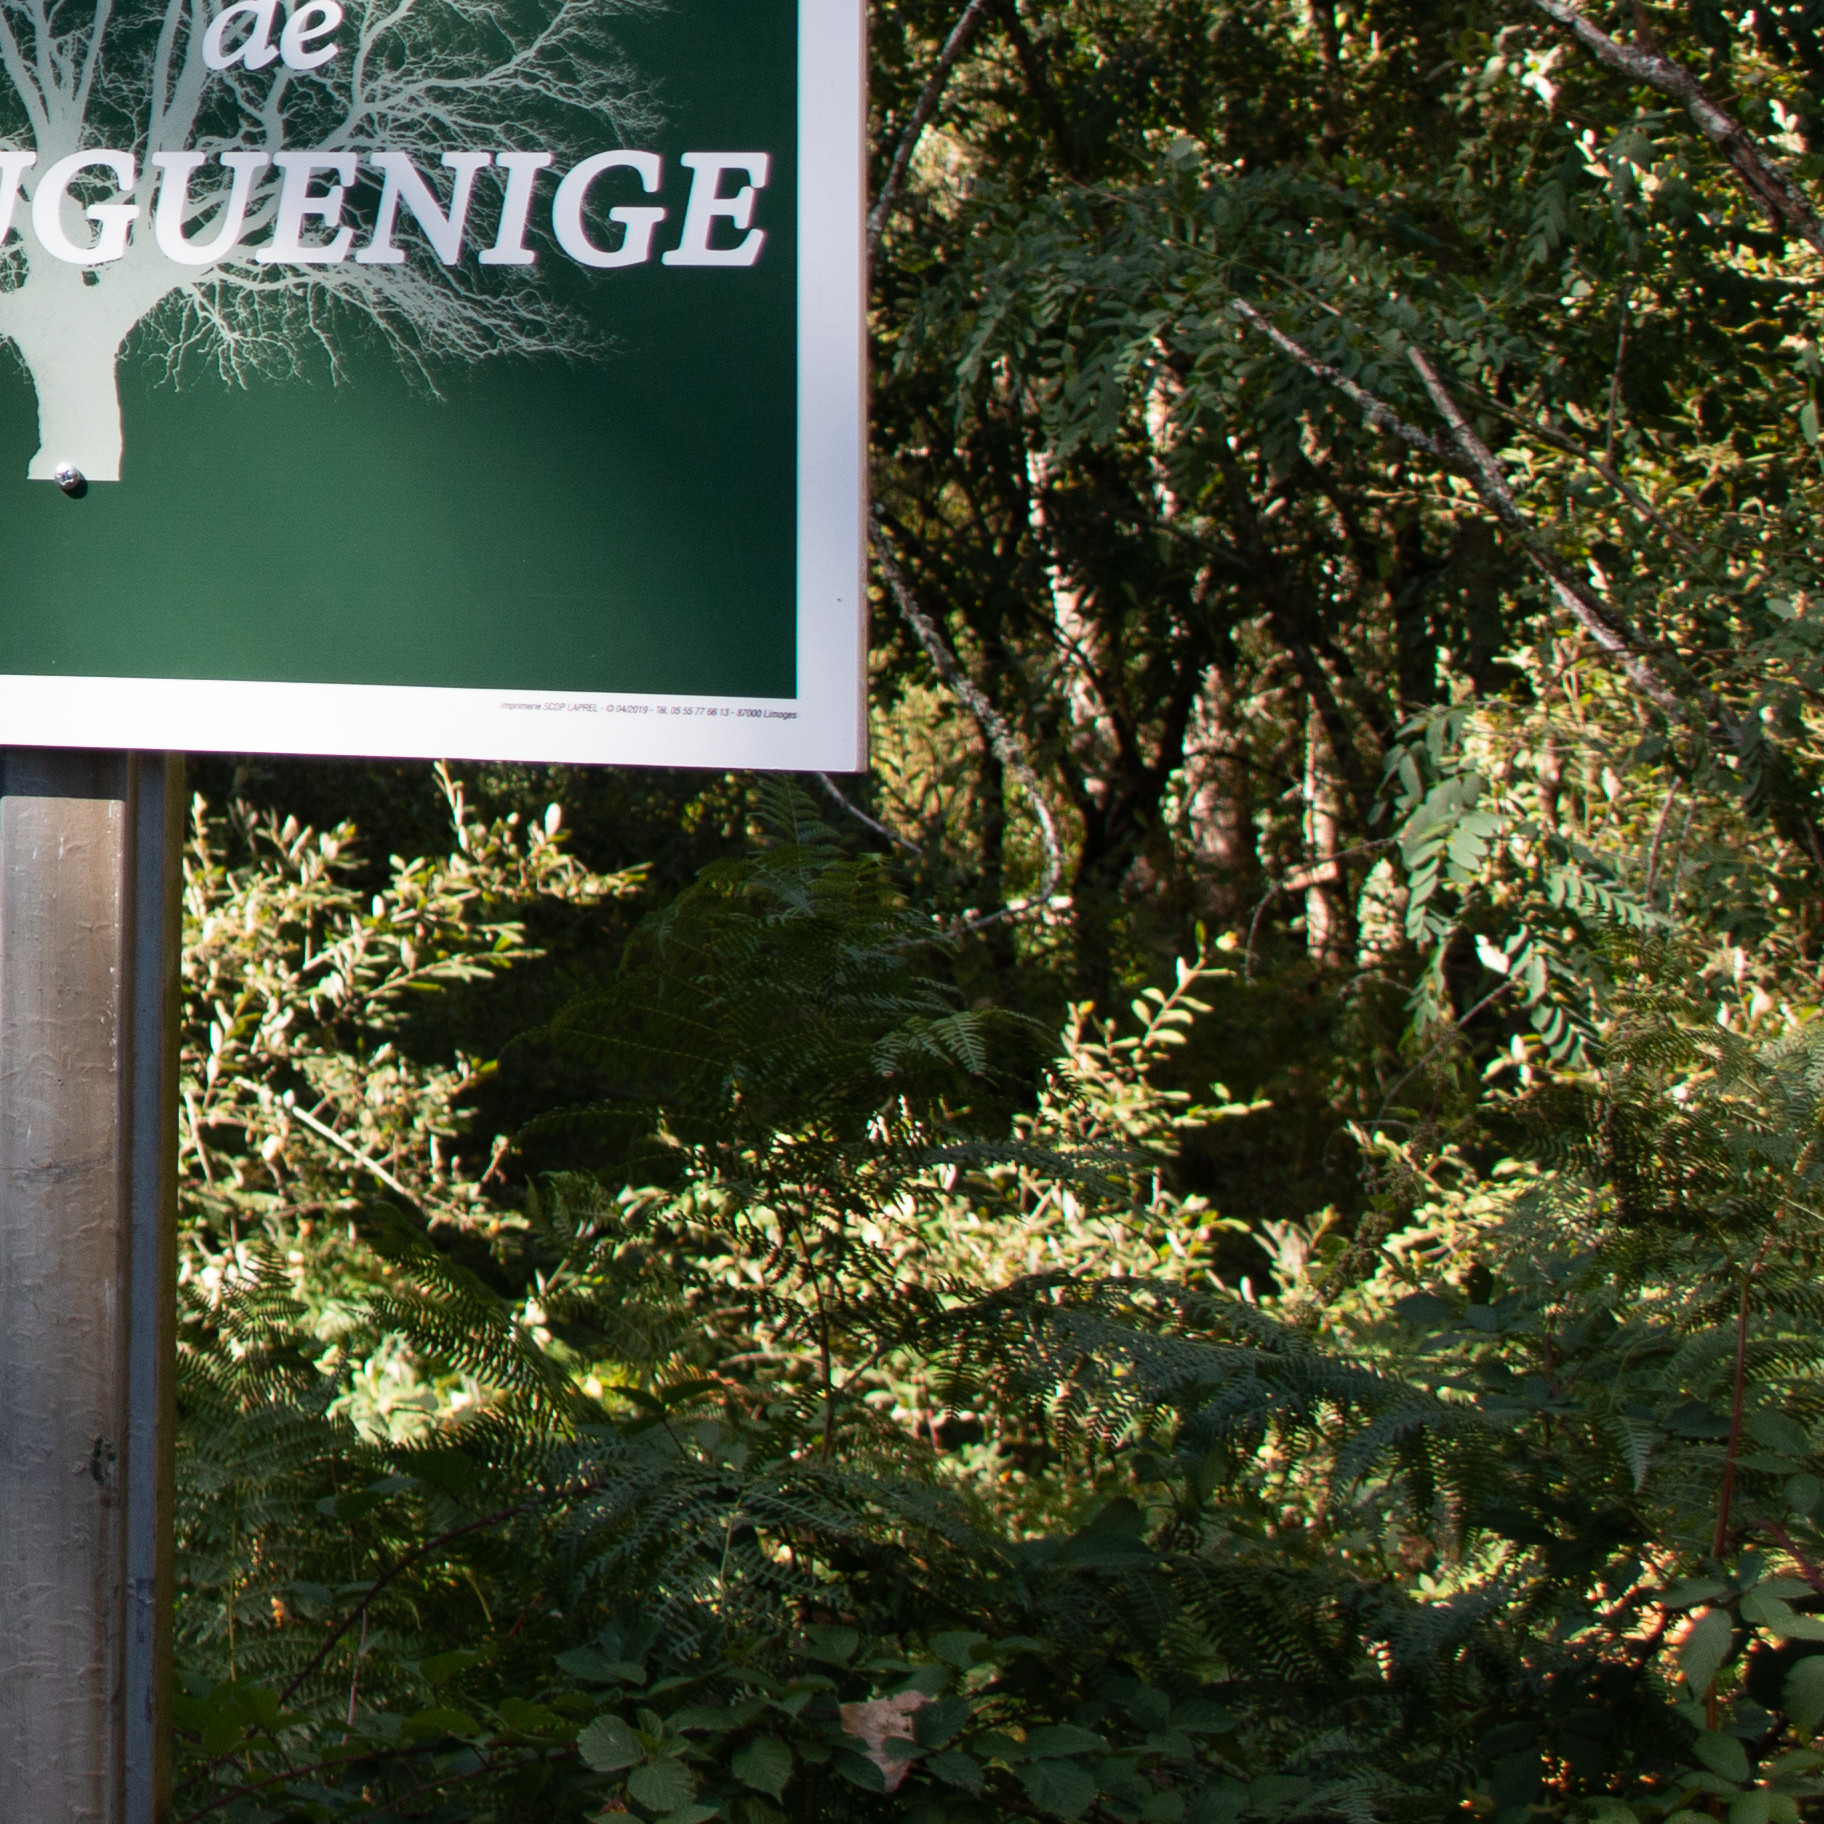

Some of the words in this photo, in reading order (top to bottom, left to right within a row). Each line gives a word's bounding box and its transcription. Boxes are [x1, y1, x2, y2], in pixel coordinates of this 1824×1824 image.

[500, 701, 541, 711] Imprimerie
[670, 706, 681, 715] 05
[682, 707, 693, 715] 55
[695, 707, 705, 716] 77
[719, 708, 729, 716] 13
[763, 709, 797, 720] Limoges
